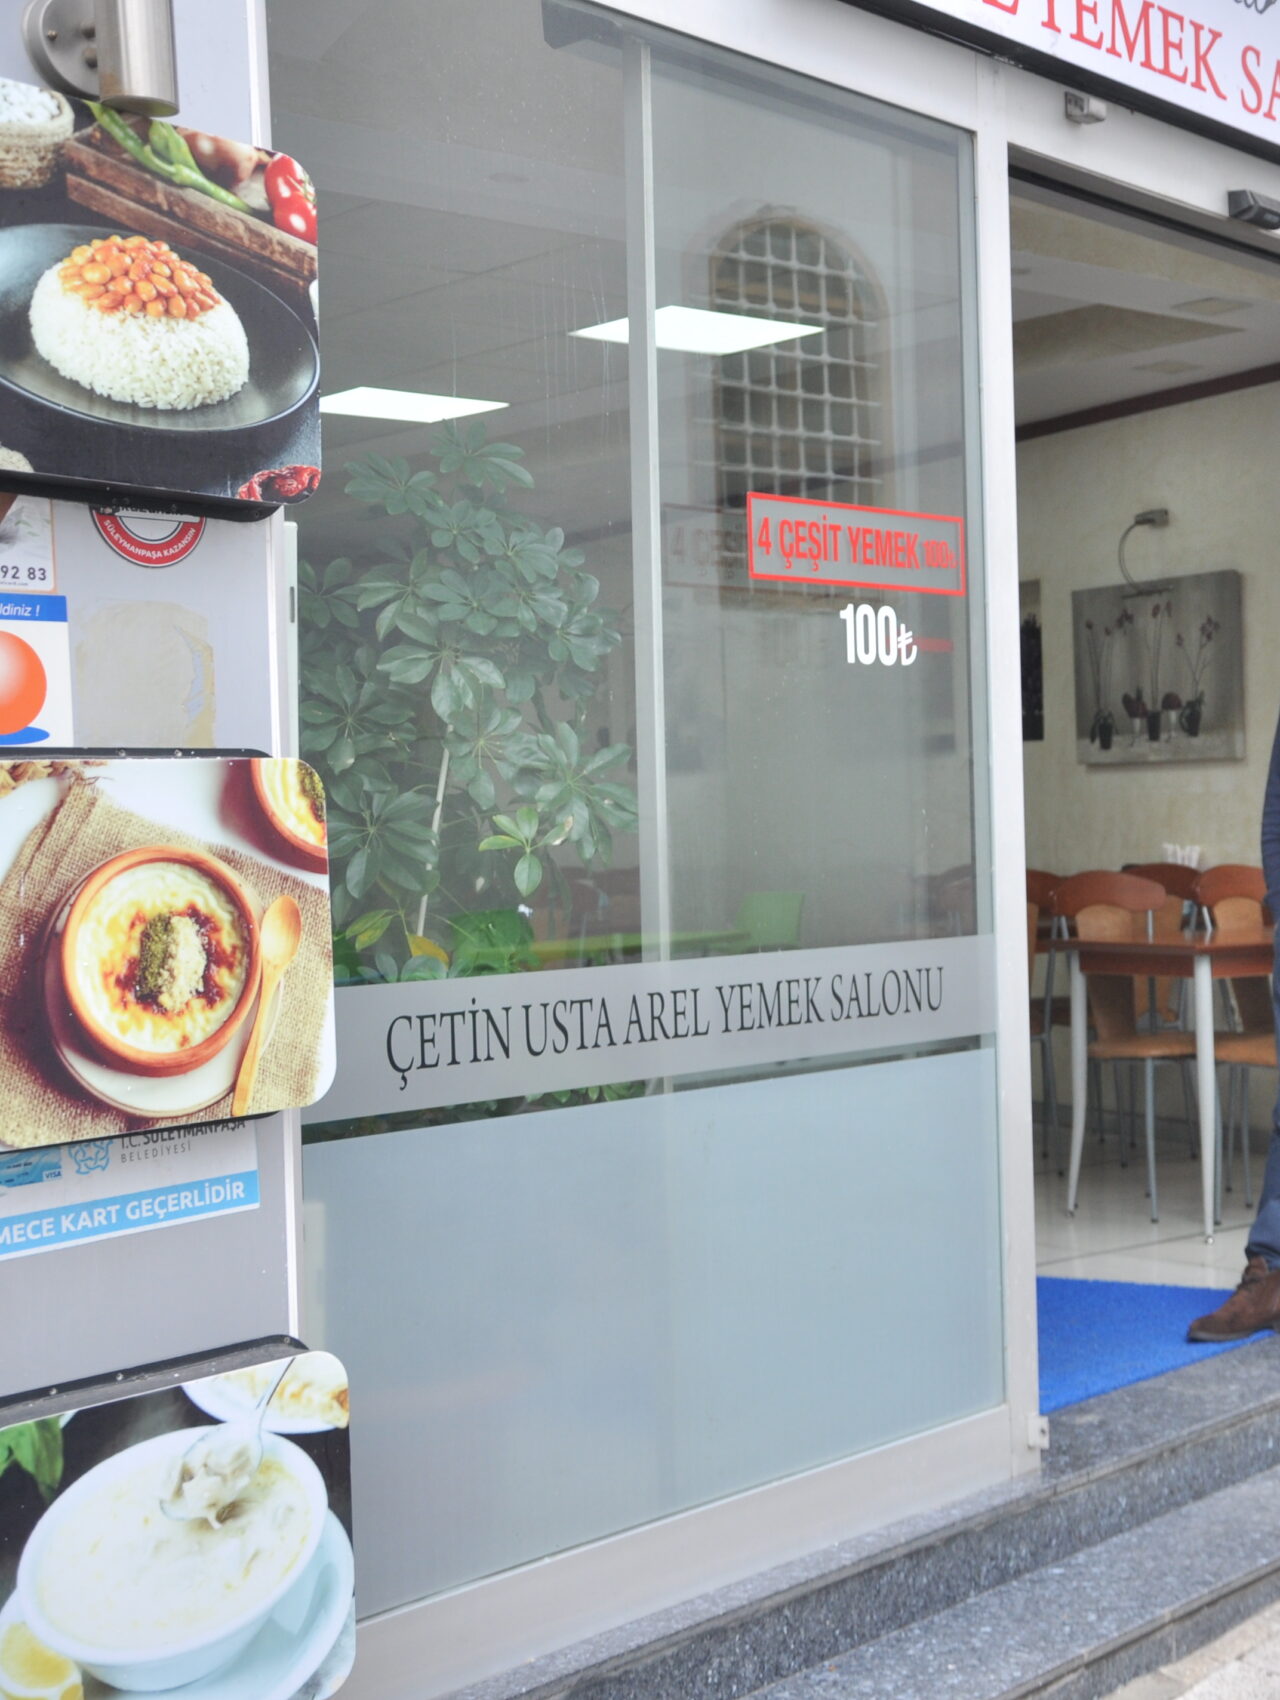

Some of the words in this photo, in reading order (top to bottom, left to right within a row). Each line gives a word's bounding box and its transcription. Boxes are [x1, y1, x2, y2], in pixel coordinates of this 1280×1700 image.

[104, 520, 162, 559] SÜLEYMANPAŞA
[163, 527, 196, 556] KAZANSIN
[757, 517, 772, 555] 4
[779, 515, 842, 571] ÇEŞİT
[848, 526, 920, 569] YEMEK
[0, 565, 20, 580] 92
[28, 567, 47, 581] 83
[840, 603, 917, 666] 100₺
[386, 997, 512, 1090] ÇETİN
[521, 998, 617, 1057] USTA
[622, 988, 710, 1045] AREL
[716, 976, 825, 1034] YEMEK
[830, 966, 944, 1022] SALONU
[121, 1140, 192, 1163] BELEDİYESİ
[61, 1204, 120, 1234] KART
[126, 1180, 245, 1220] GEÇERLİDİR
